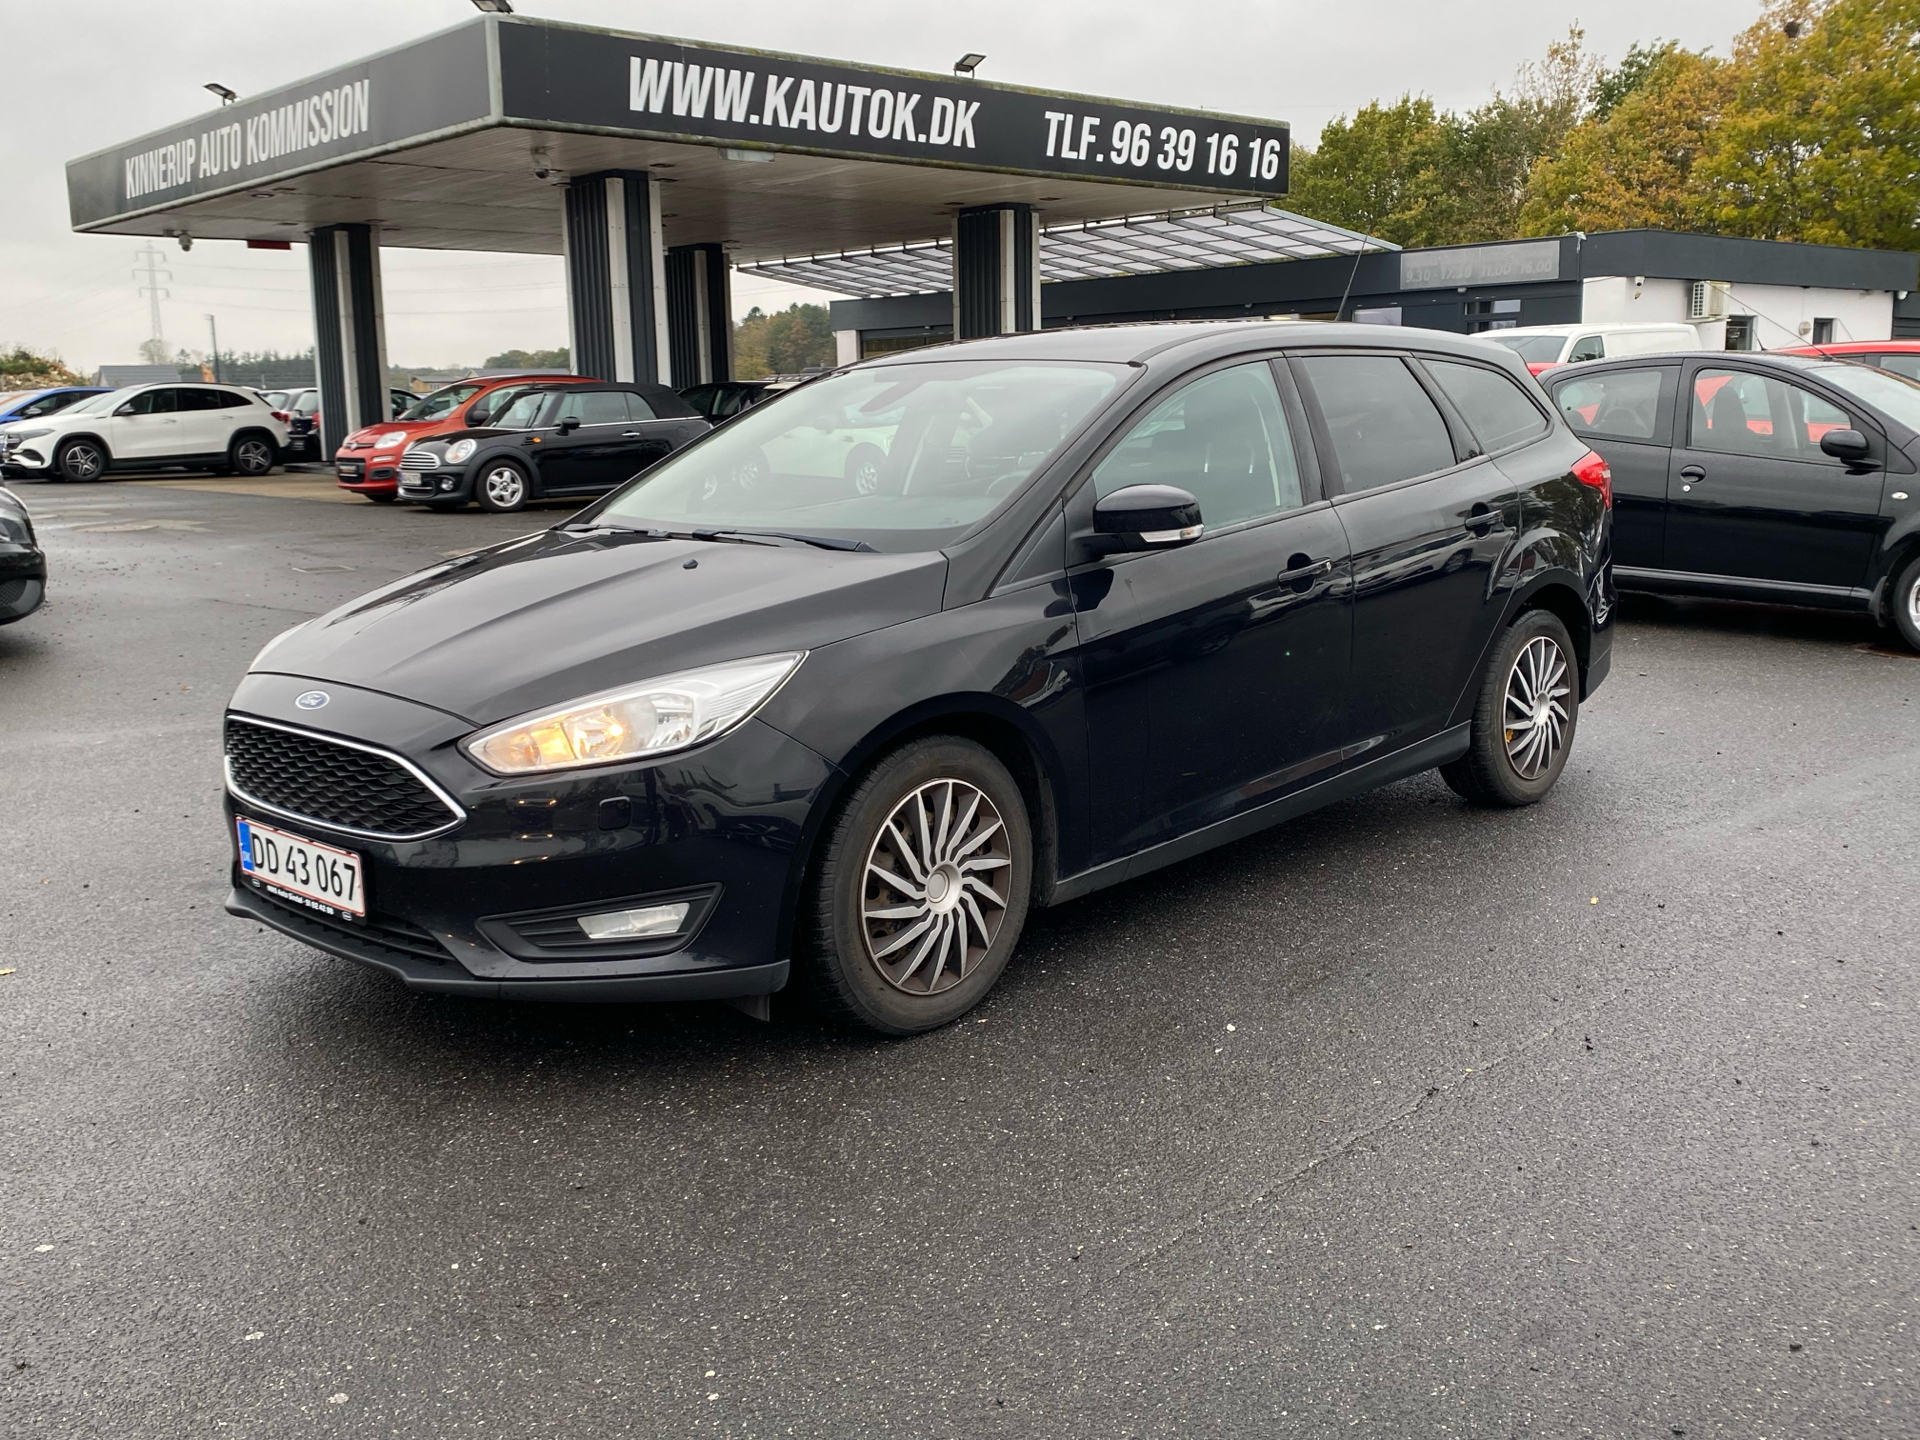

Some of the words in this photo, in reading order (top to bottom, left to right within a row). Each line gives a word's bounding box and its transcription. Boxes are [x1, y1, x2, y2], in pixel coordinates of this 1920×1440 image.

[629, 56, 981, 148] WWW.KAUTOK.DK
[126, 138, 195, 199] KINNERUP
[199, 122, 242, 178] AUTO
[246, 79, 370, 165] KOMMISSION
[1045, 110, 1104, 162] TLF.
[1110, 120, 1151, 167] 96
[1157, 126, 1196, 172] 39
[1206, 132, 1239, 176] 16
[1249, 137, 1281, 180] 16
[1405, 269, 1431, 283] 9.30
[251, 832, 279, 874] DD
[286, 845, 310, 886] 43
[315, 854, 356, 901] 067
